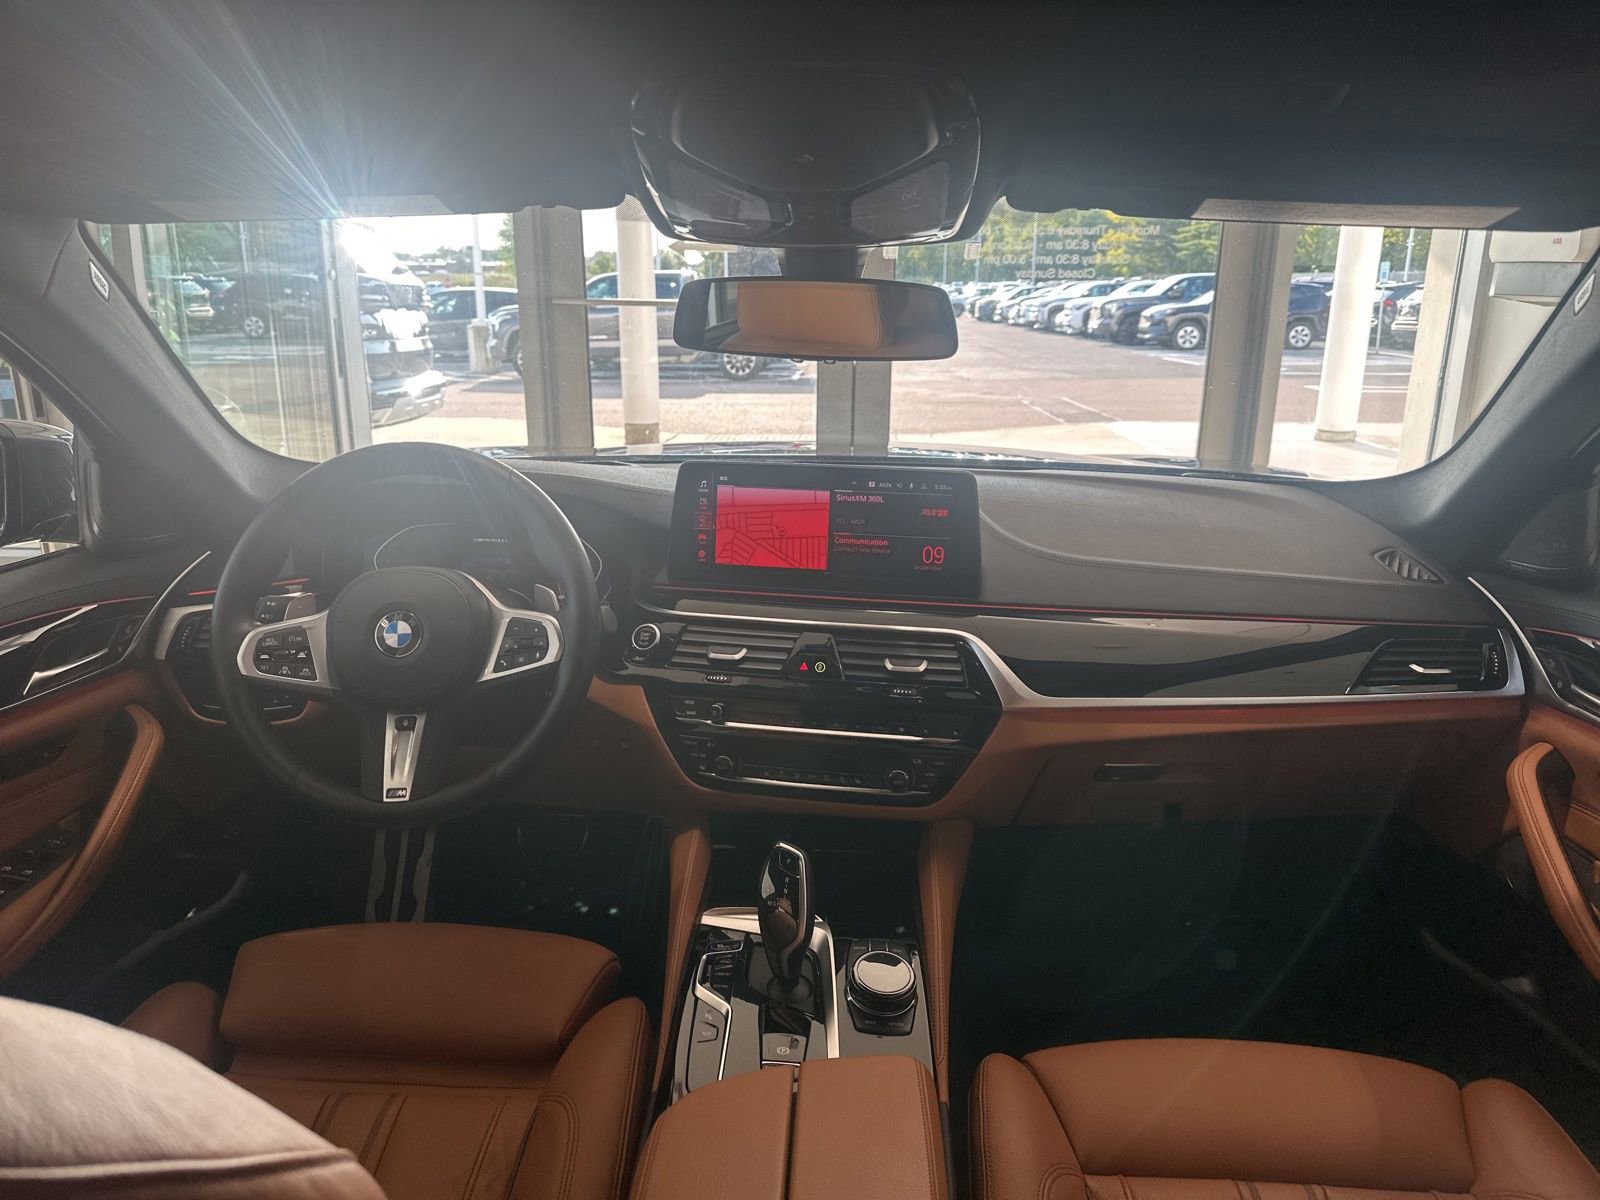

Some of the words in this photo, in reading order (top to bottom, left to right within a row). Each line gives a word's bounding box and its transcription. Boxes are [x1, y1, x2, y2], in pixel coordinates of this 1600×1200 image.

[836, 494, 867, 503] SiriusXM
[867, 495, 885, 503] 360L
[834, 536, 889, 546] Communication
[922, 545, 945, 564] 09
